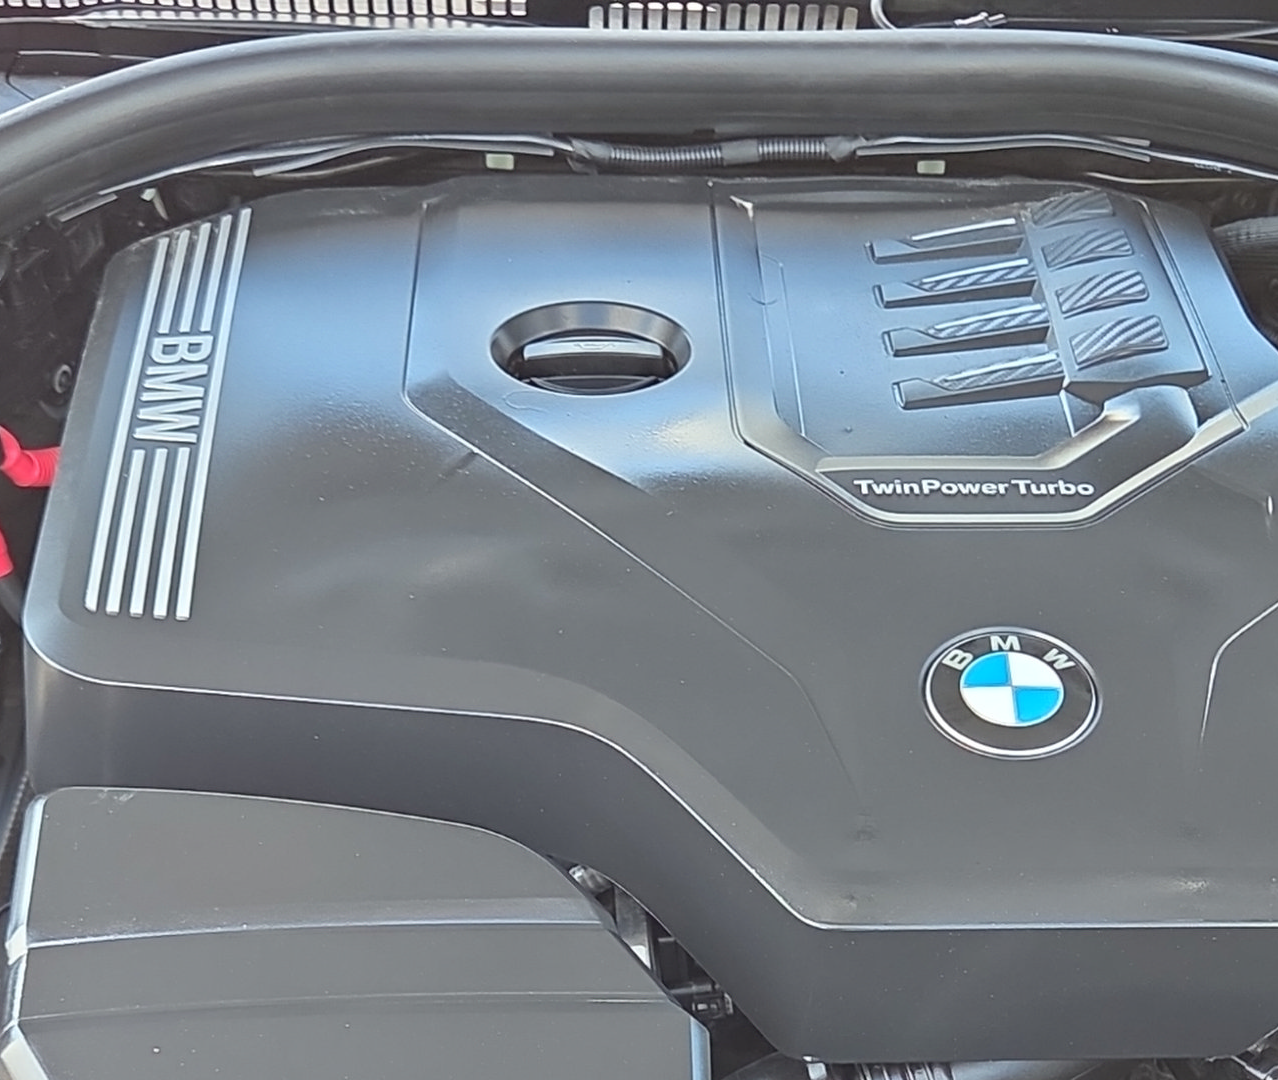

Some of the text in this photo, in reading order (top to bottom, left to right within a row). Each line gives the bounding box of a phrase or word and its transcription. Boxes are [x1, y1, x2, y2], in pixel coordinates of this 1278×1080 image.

[132, 334, 214, 443] BMW
[853, 478, 1096, 496] TwinPower Turbo
[940, 635, 1077, 671] BMW
